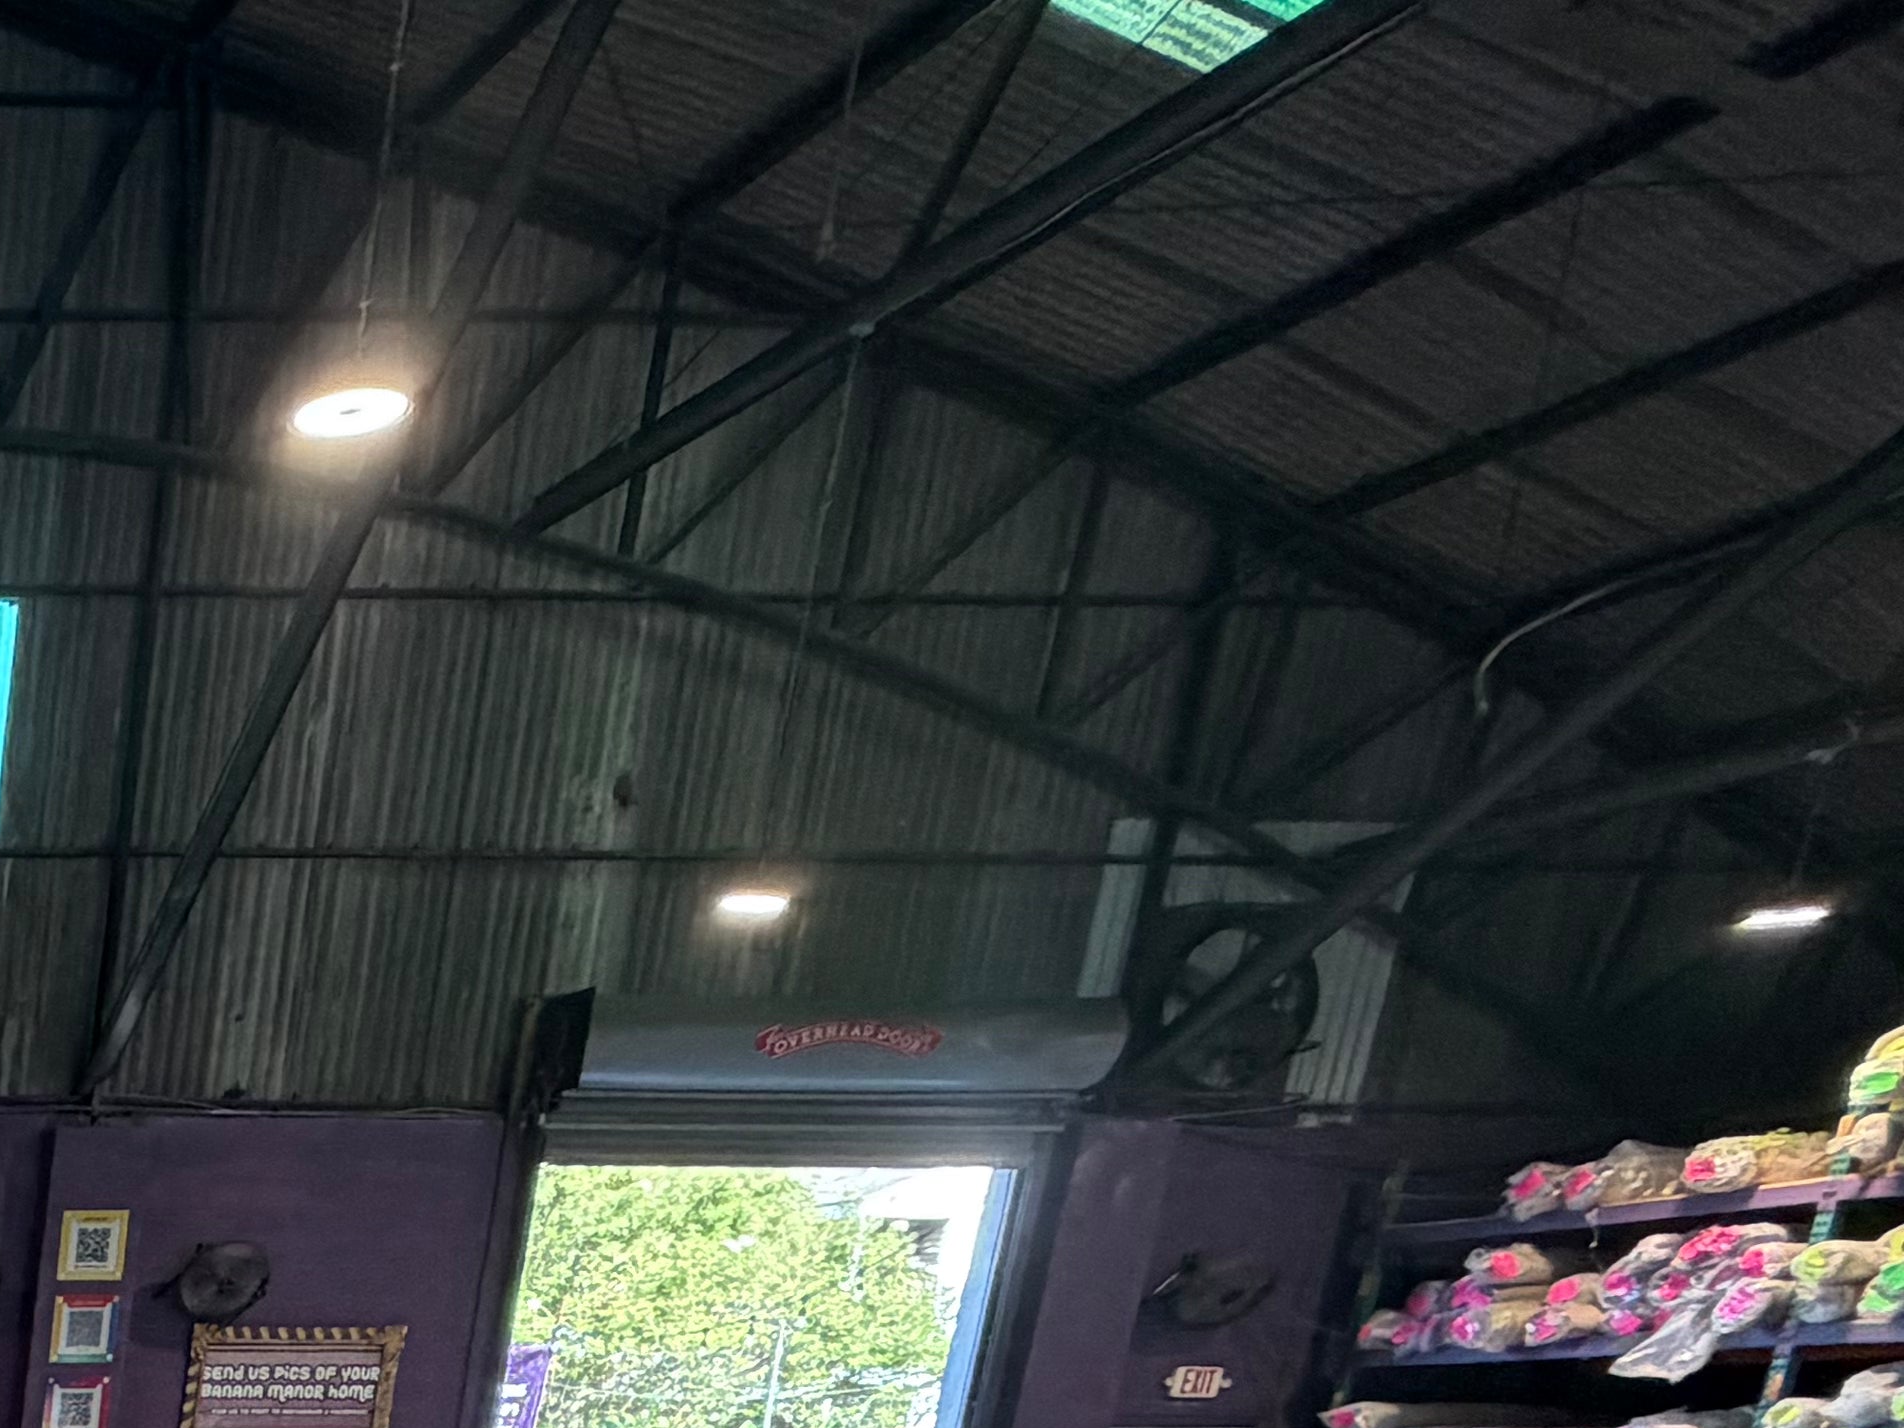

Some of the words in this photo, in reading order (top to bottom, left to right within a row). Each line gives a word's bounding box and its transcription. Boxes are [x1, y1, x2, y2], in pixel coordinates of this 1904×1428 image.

[248, 1366, 270, 1381] US
[315, 1366, 338, 1381] OF
[342, 1366, 381, 1381] YOUR
[1180, 1369, 1218, 1394] EXIT
[201, 1384, 264, 1399] BANANA
[267, 1384, 324, 1402] MANOR
